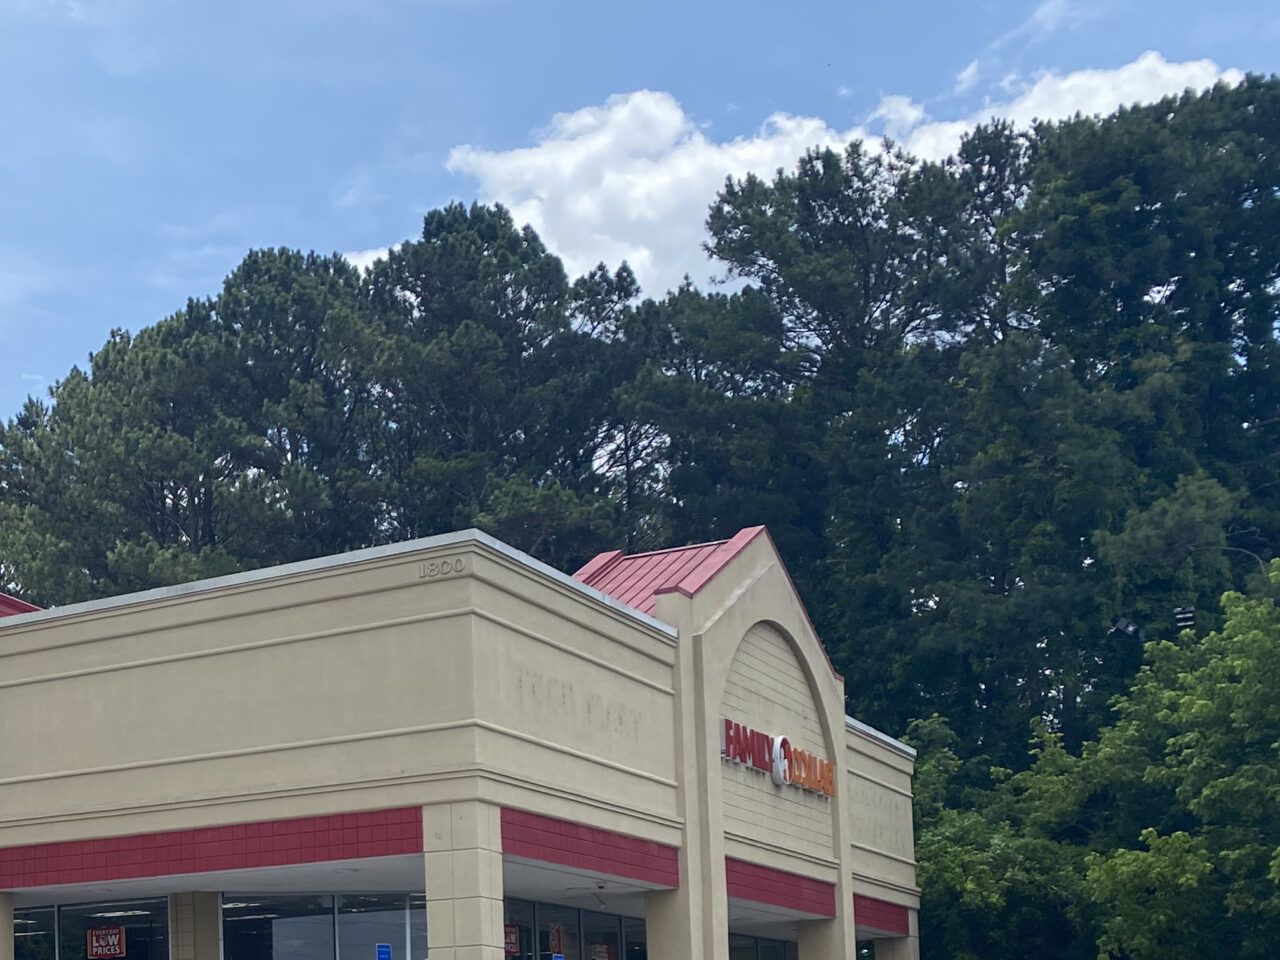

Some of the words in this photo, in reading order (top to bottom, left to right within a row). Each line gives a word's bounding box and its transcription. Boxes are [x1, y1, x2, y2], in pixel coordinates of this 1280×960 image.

[419, 558, 465, 578] 1800
[724, 718, 774, 772] FAMILY
[792, 747, 836, 798] DOLLAR
[93, 935, 119, 947] LOW
[93, 945, 120, 955] PRICES
